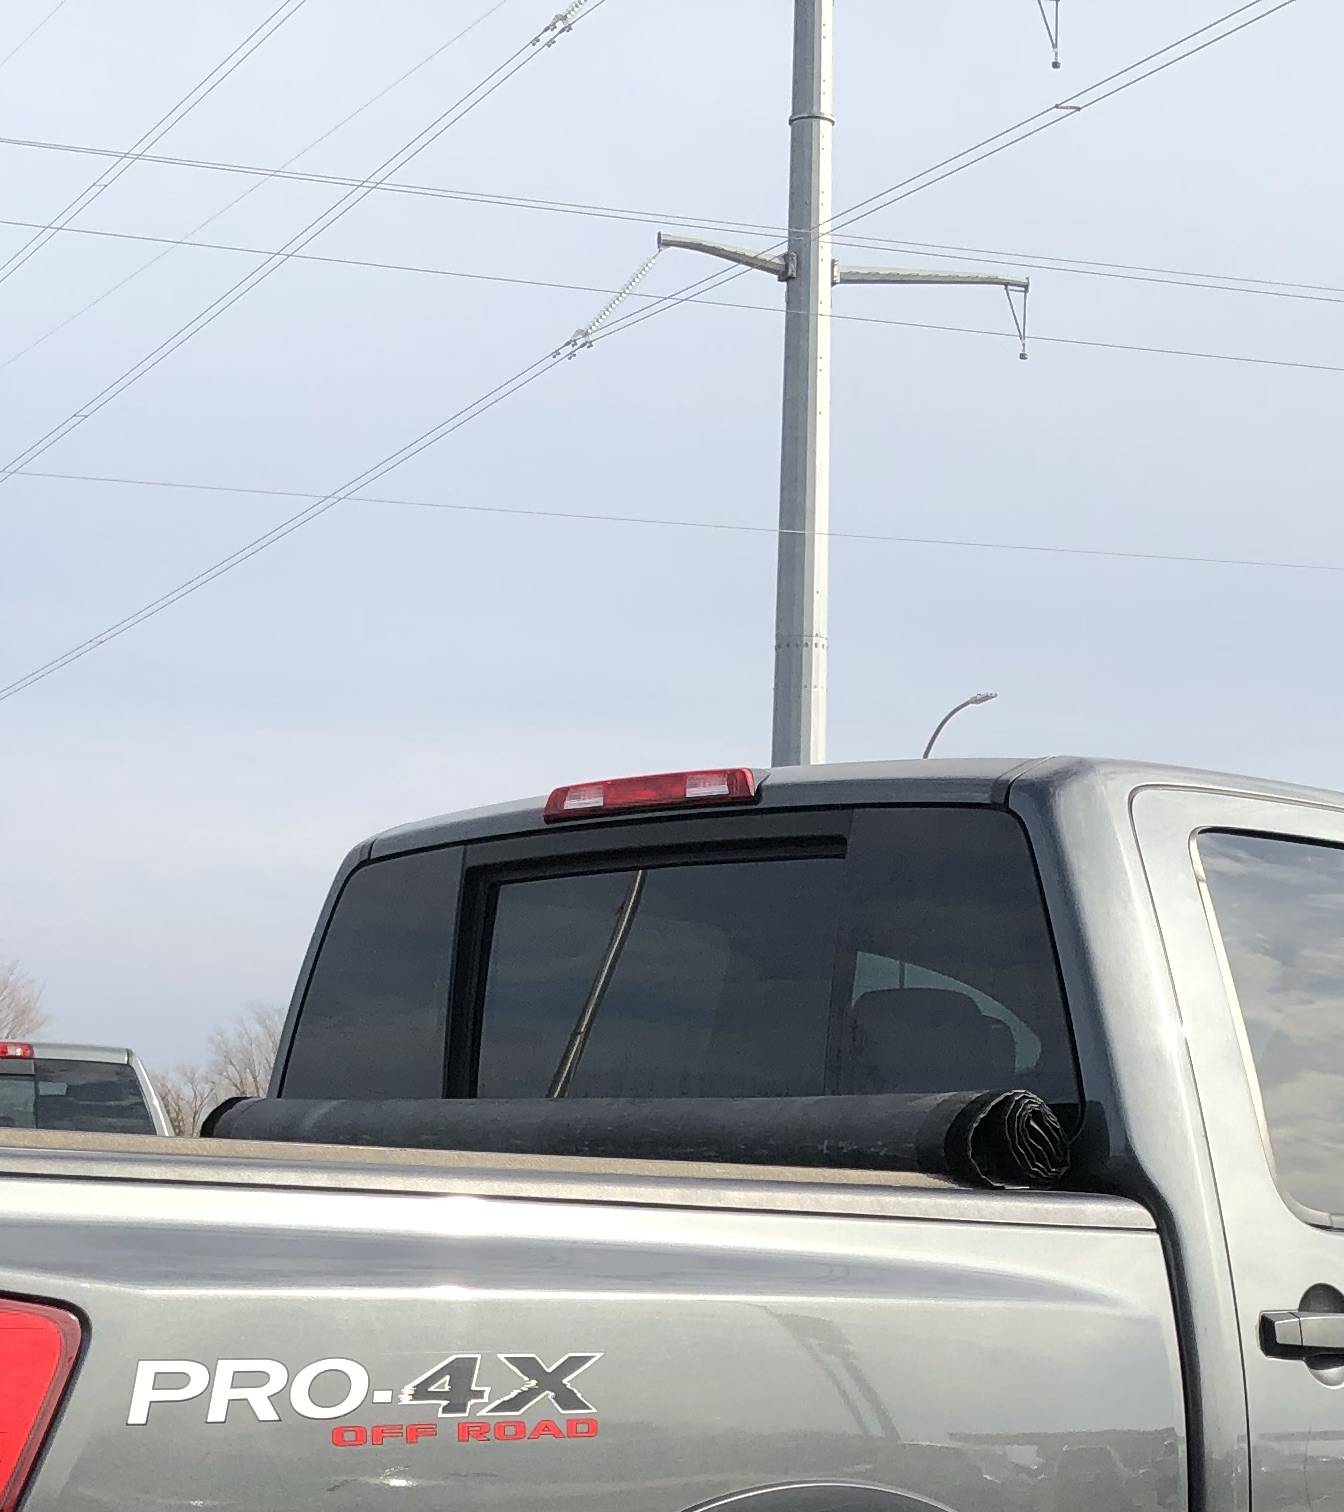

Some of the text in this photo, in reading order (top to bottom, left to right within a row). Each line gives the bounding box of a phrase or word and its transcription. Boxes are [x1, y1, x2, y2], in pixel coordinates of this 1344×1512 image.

[126, 1352, 604, 1426] PRO-4X
[331, 1418, 599, 1447] OFF ROAD
